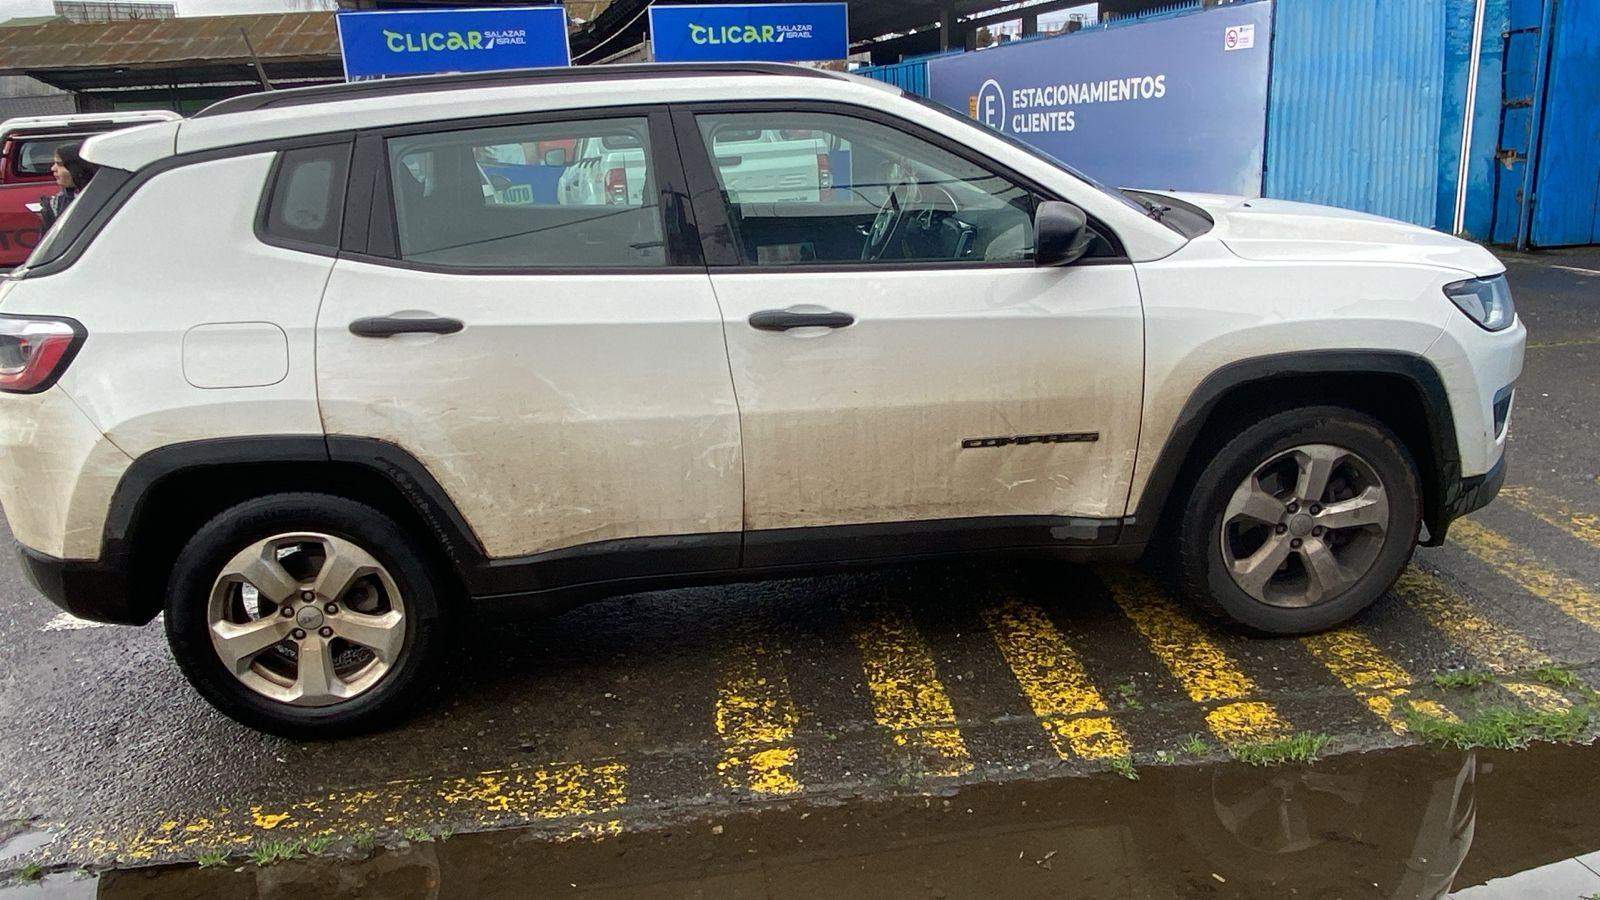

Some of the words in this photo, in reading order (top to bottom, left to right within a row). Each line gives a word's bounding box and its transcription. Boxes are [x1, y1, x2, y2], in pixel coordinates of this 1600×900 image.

[776, 24, 813, 32] SALAZAR
[484, 29, 526, 38] SALAZAR
[786, 31, 812, 39] ISRAEL
[496, 37, 526, 45] ISRAEL
[1012, 74, 1166, 109] ESTACIONAMIENTOS
[985, 95, 996, 128] E
[1012, 110, 1075, 133] CLIENTES
